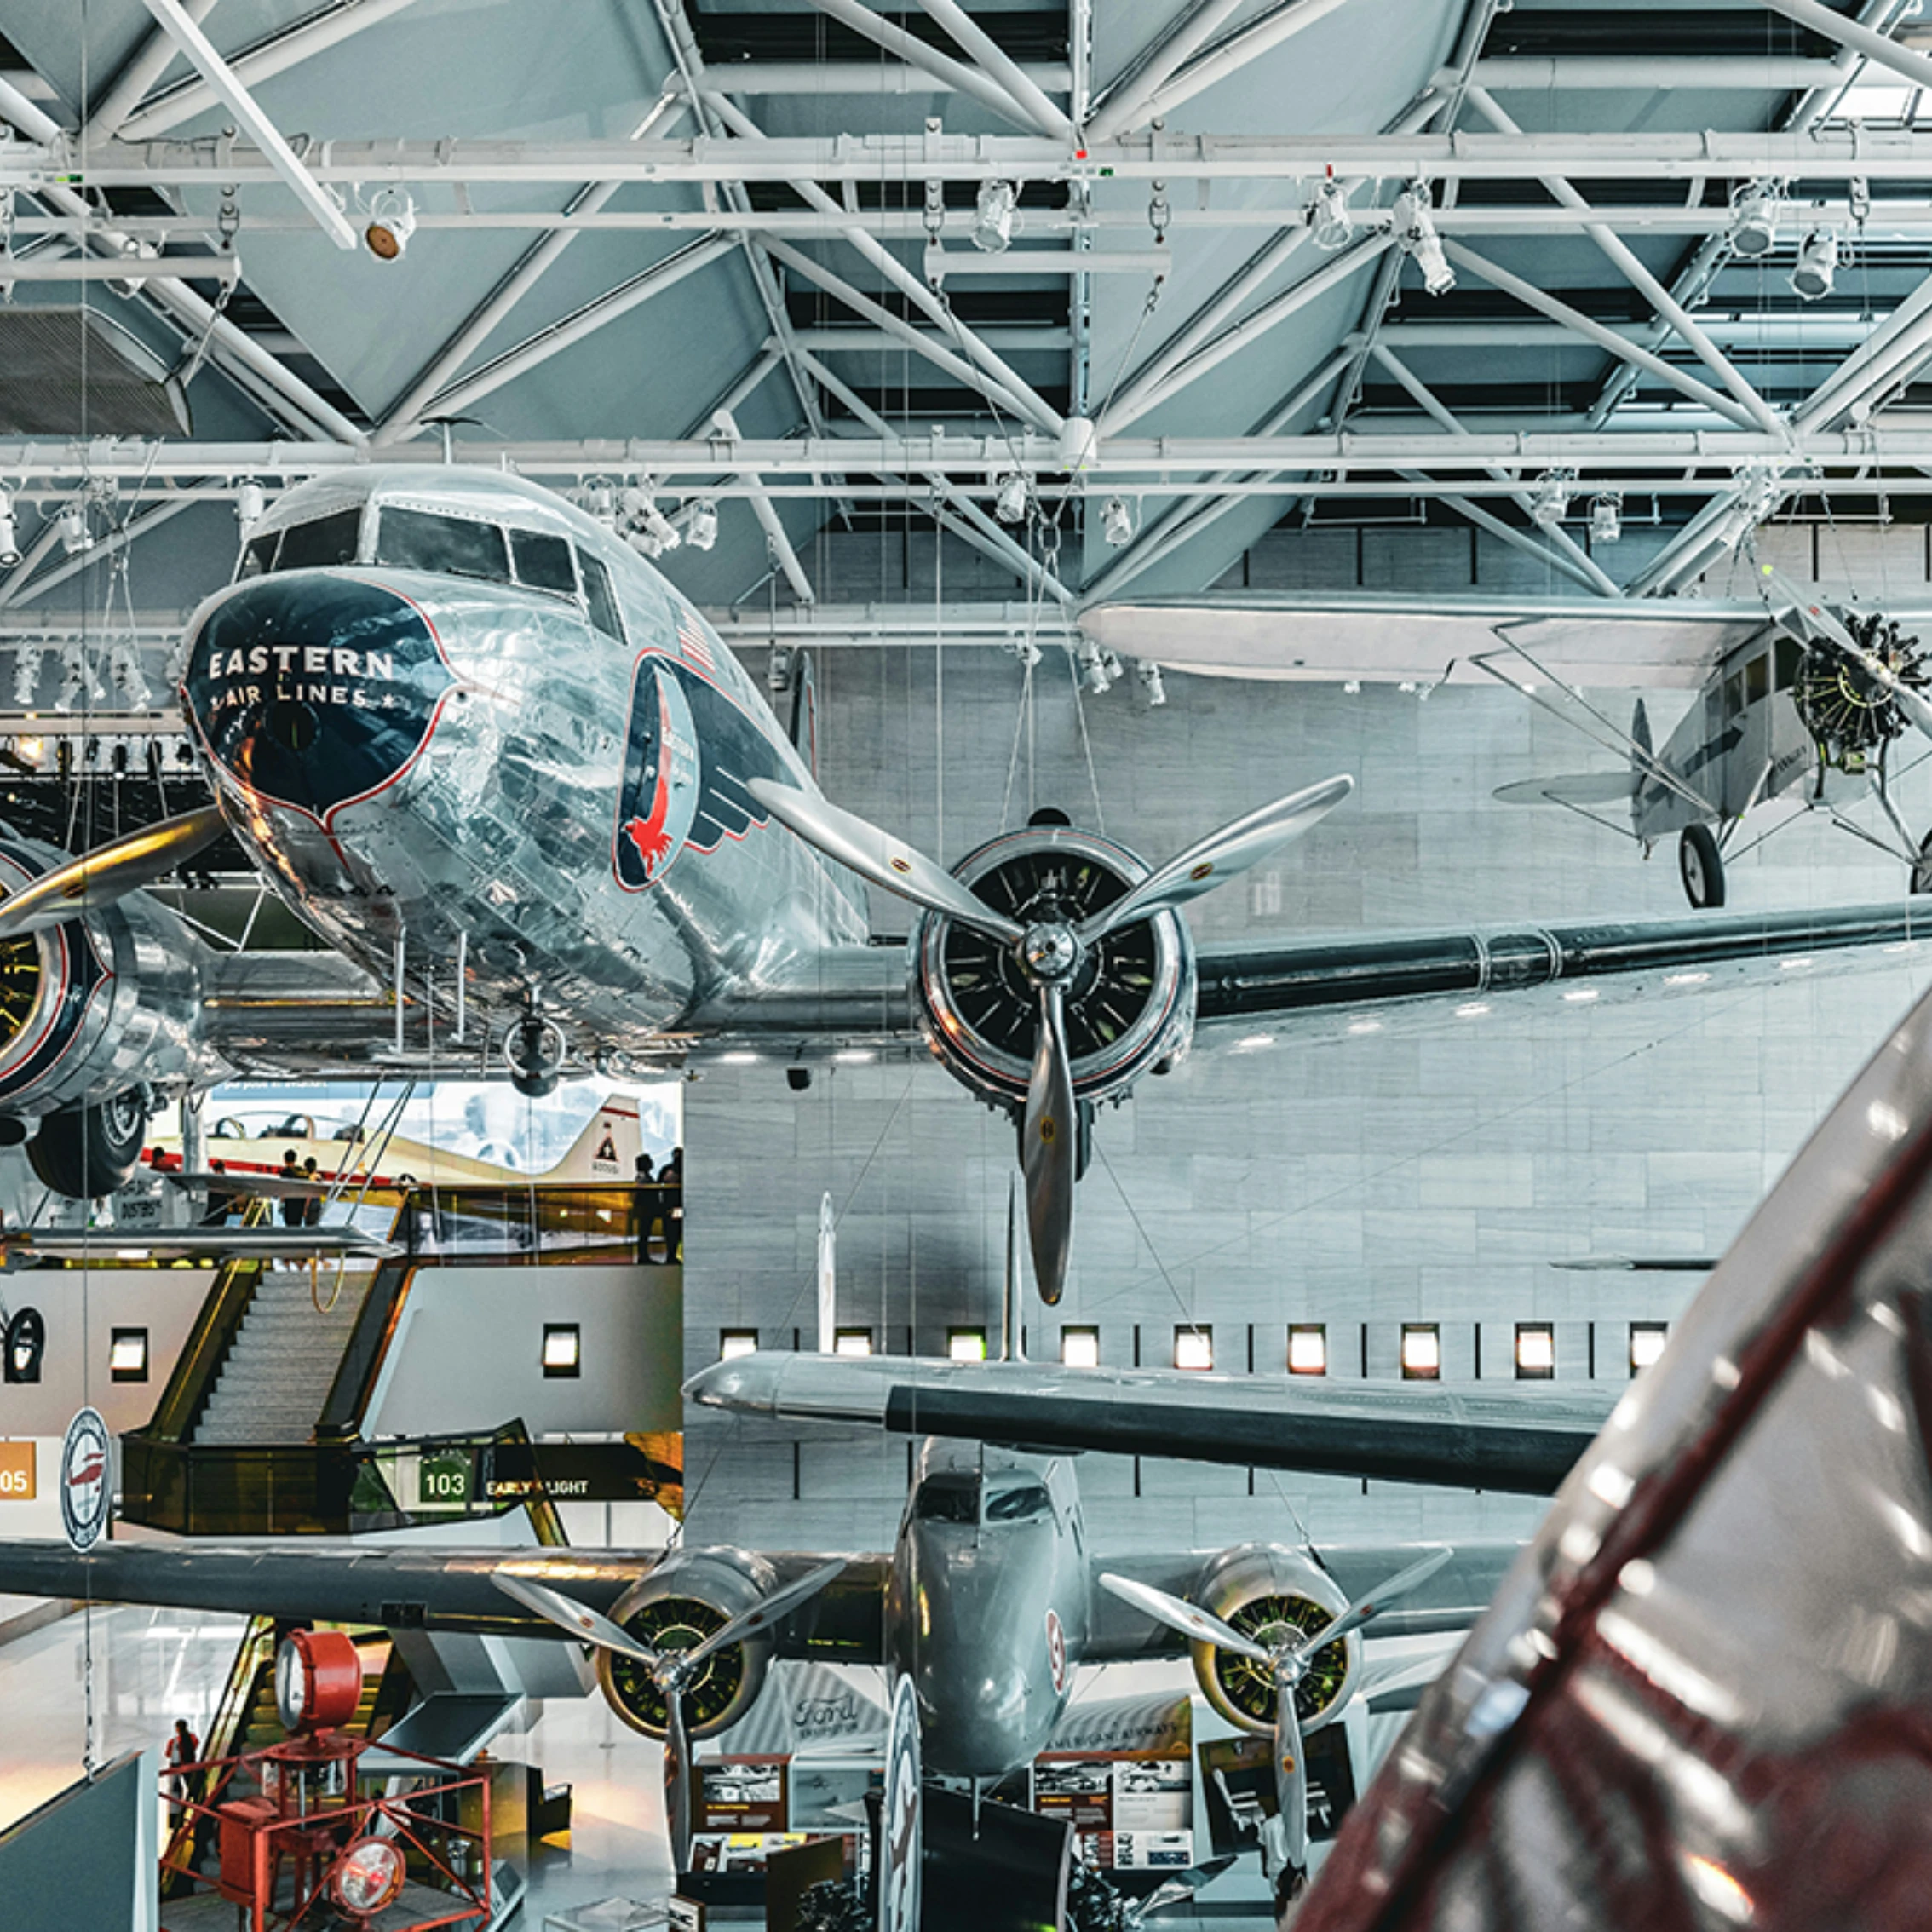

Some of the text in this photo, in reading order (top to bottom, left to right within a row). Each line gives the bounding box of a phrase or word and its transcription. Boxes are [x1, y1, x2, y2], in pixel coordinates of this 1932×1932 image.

[209, 646, 394, 680] EASTERN
[226, 683, 366, 707] AIR LINES
[426, 1474, 465, 1495] 103
[486, 1480, 532, 1496] EARLY
